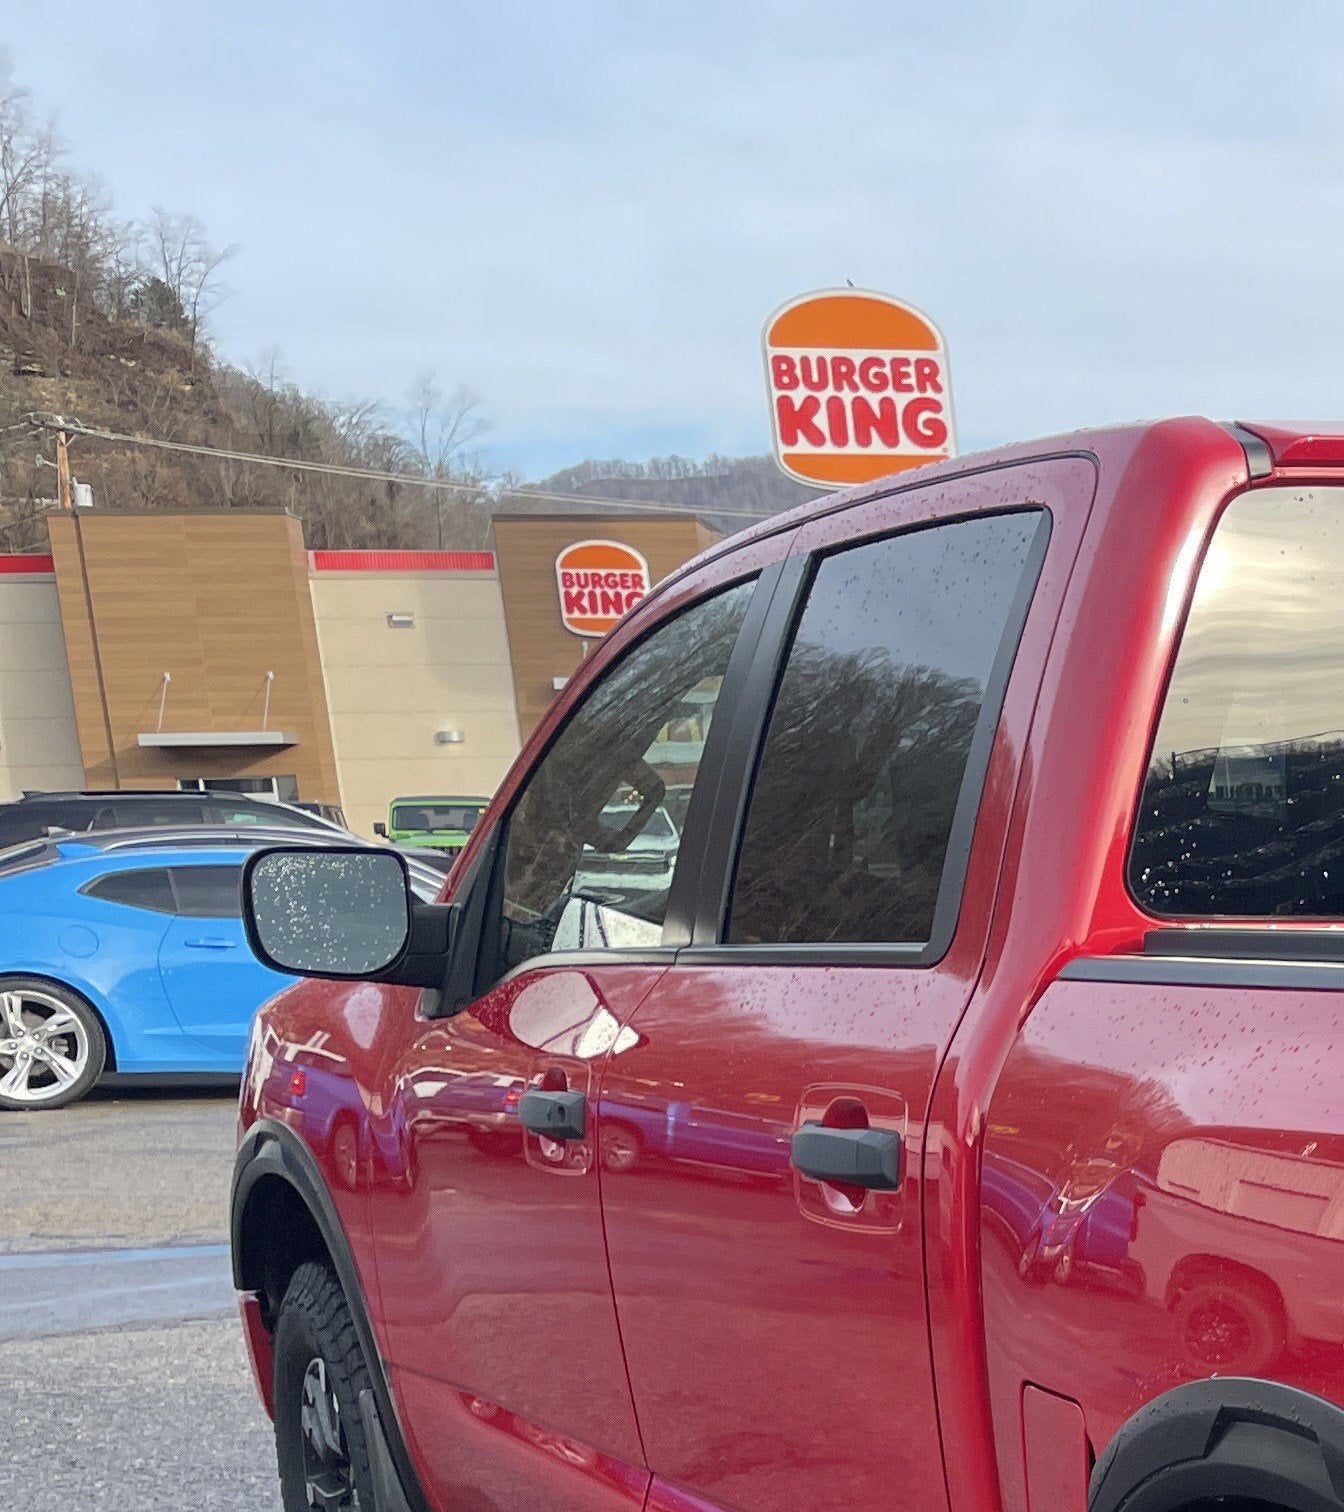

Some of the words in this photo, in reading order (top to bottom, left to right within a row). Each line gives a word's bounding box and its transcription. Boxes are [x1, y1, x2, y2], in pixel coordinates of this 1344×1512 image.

[771, 355, 943, 394] BURGER
[777, 395, 948, 448] KING
[561, 571, 645, 590] BURGER
